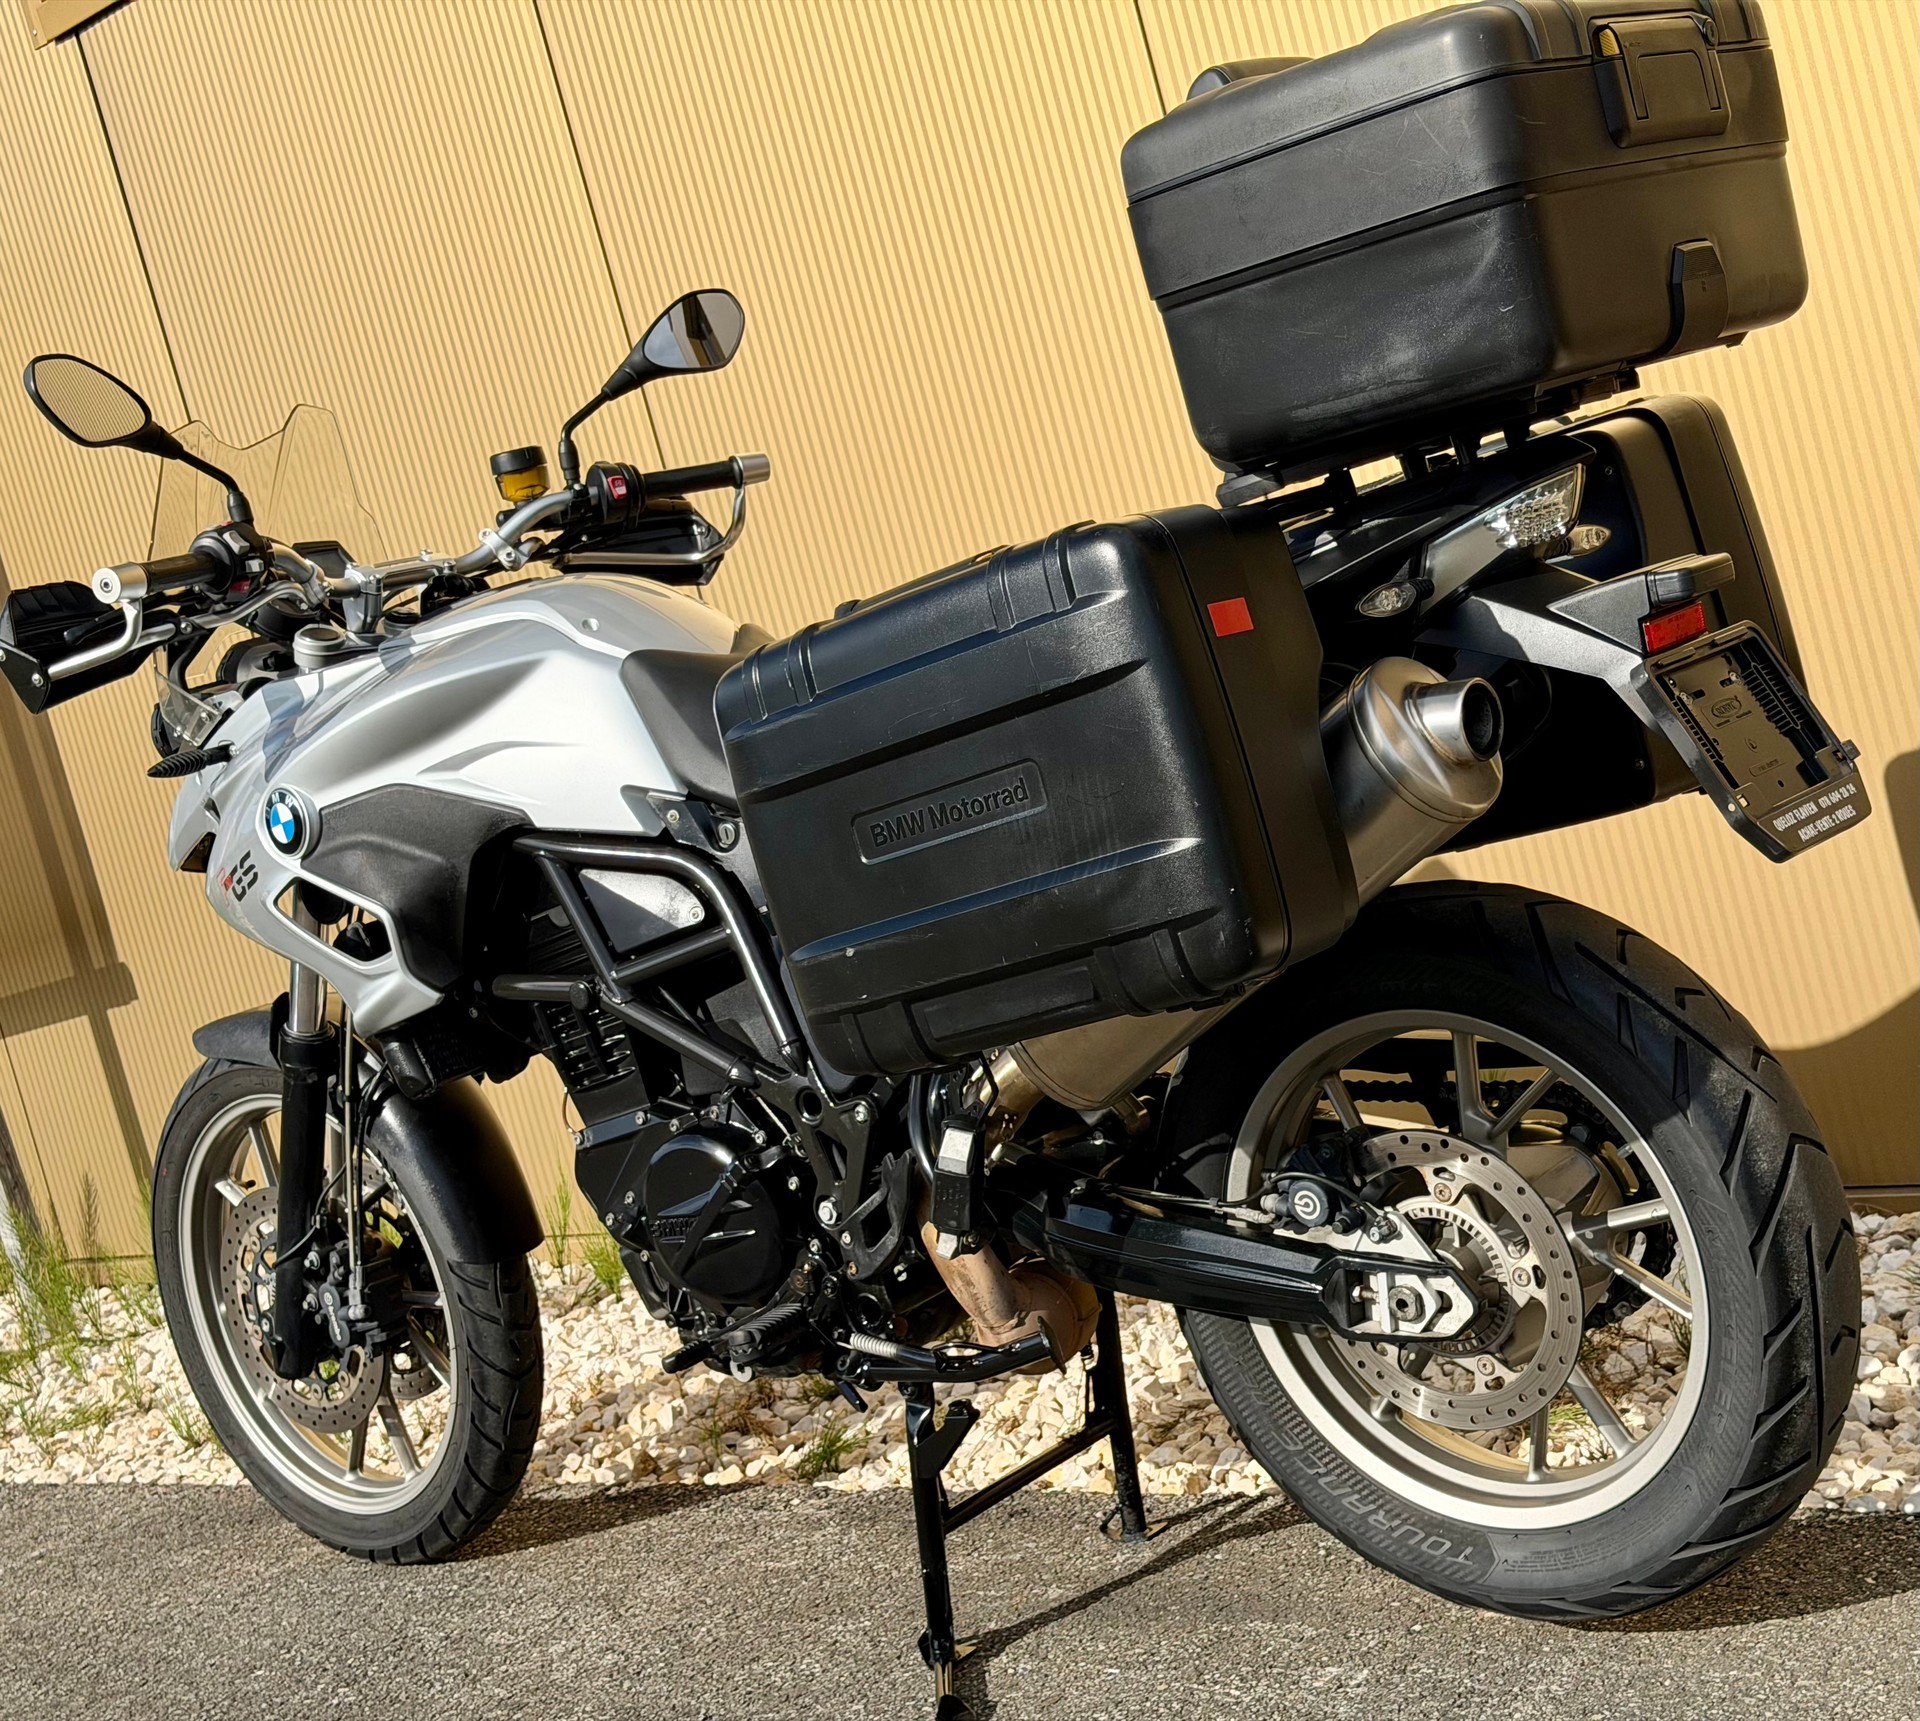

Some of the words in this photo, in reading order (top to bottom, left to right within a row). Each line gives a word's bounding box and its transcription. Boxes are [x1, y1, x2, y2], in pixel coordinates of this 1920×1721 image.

[869, 809, 926, 847] BMW
[927, 776, 1029, 831] Motorrad
[1793, 800, 1819, 821] FLAVIEN
[1846, 782, 1857, 795] 24
[1831, 813, 1840, 825] 2
[1835, 804, 1857, 822] ROUES
[1269, 1430, 1475, 1566] TOURANCE
